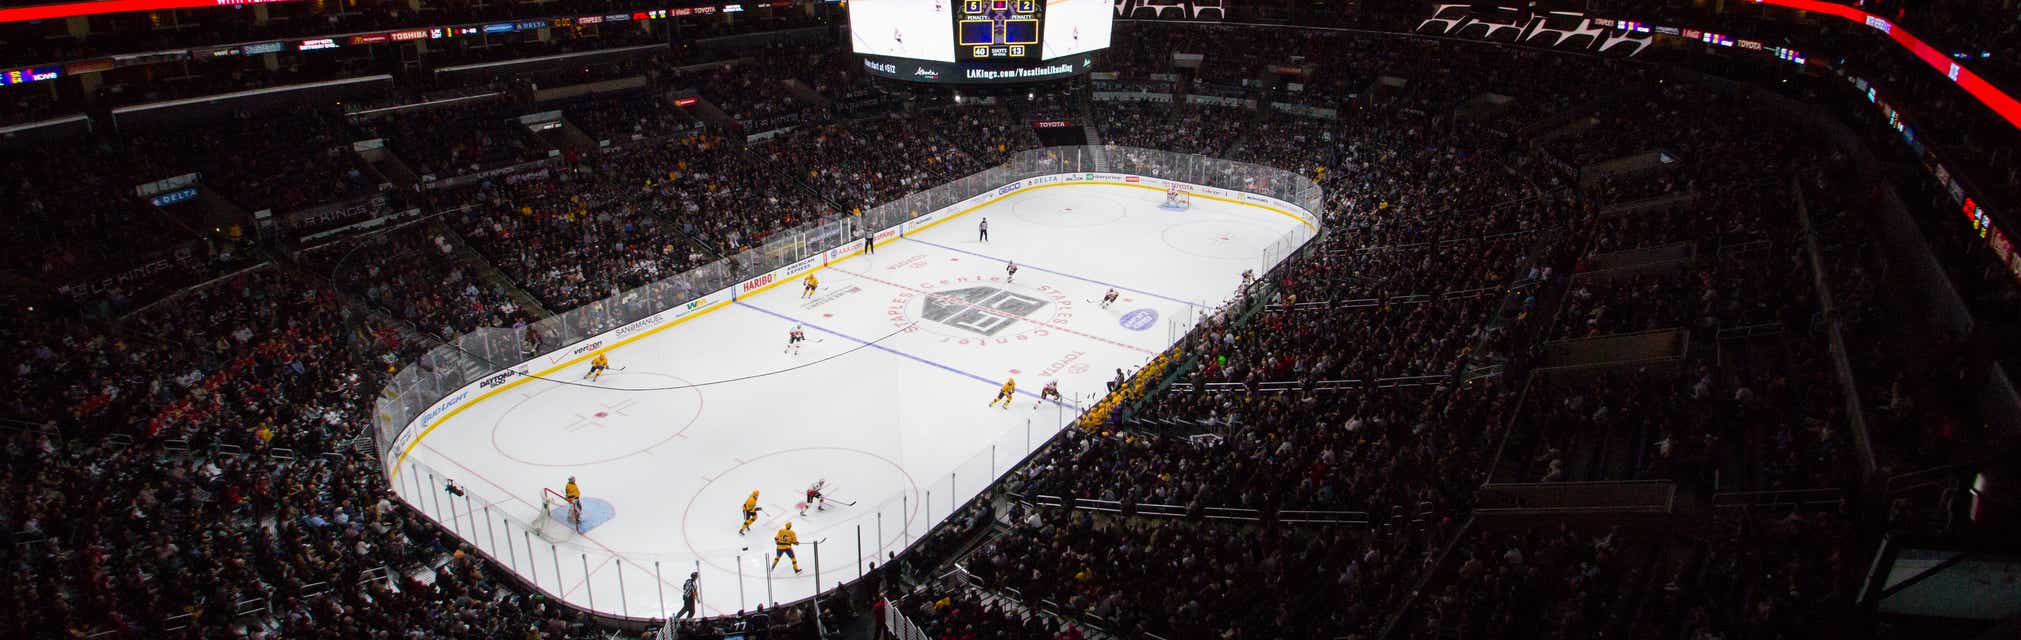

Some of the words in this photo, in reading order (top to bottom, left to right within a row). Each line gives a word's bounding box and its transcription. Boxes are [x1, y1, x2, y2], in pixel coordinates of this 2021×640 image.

[694, 6, 716, 14] TOYOTA
[1023, 1, 1030, 10] 2
[523, 21, 546, 29] DELTA
[391, 30, 428, 41] TOSHIBA
[1012, 47, 1022, 55] 13
[1737, 39, 1762, 51] TOYOTA
[975, 48, 986, 56] 40
[1034, 176, 1057, 185] DELTA
[1171, 182, 1194, 191] TOYOTA
[999, 182, 1021, 195] GEICO
[163, 188, 197, 203] DELTA
[787, 257, 815, 271] AMERICAN
[787, 264, 810, 276] EXPRESS
[743, 273, 773, 293] HARIBO
[635, 314, 663, 331] MANUEL
[573, 340, 602, 355] verizon
[1039, 350, 1085, 378] TOYOTA
[480, 370, 515, 388] DAYTONA
[441, 391, 468, 412] LIGHT
[734, 621, 747, 631] 77
